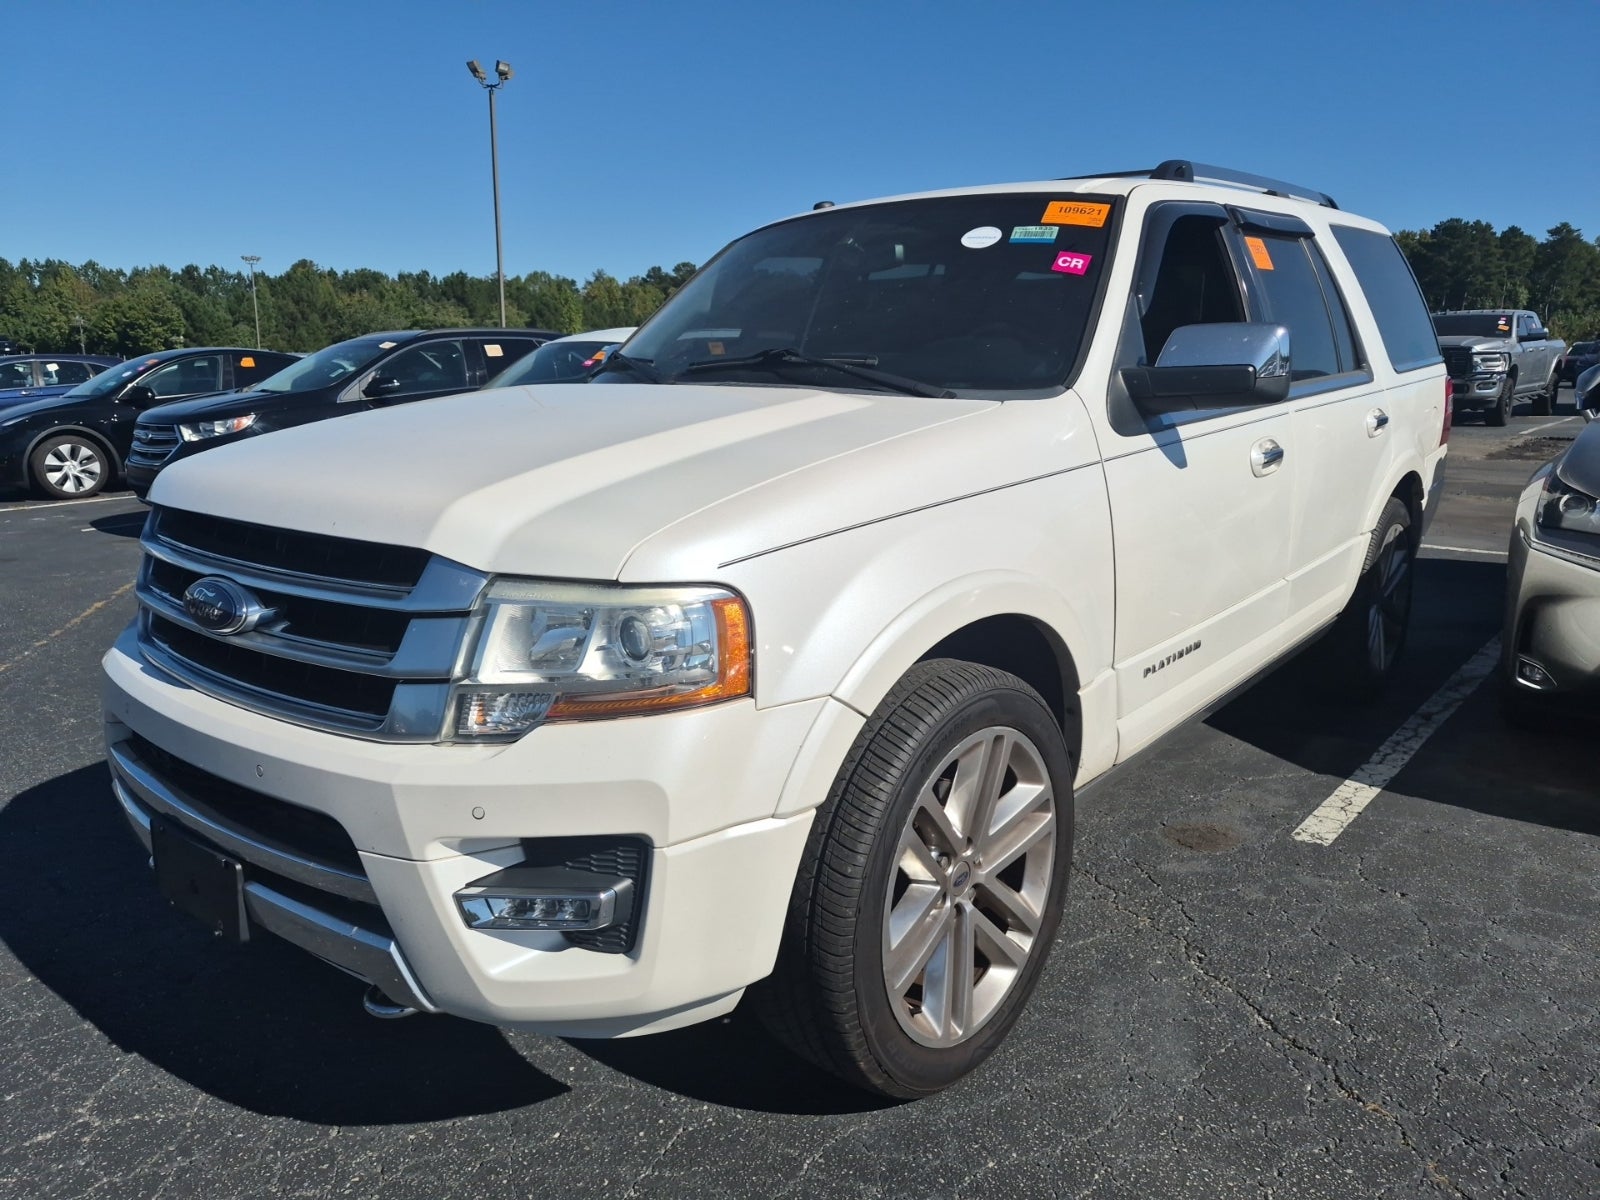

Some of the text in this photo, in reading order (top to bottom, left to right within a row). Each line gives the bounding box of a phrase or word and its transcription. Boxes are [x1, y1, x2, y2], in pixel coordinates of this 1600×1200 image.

[1058, 206, 1102, 216] 109621
[1057, 256, 1085, 269] CR
[1143, 640, 1202, 679] PLATINUM
